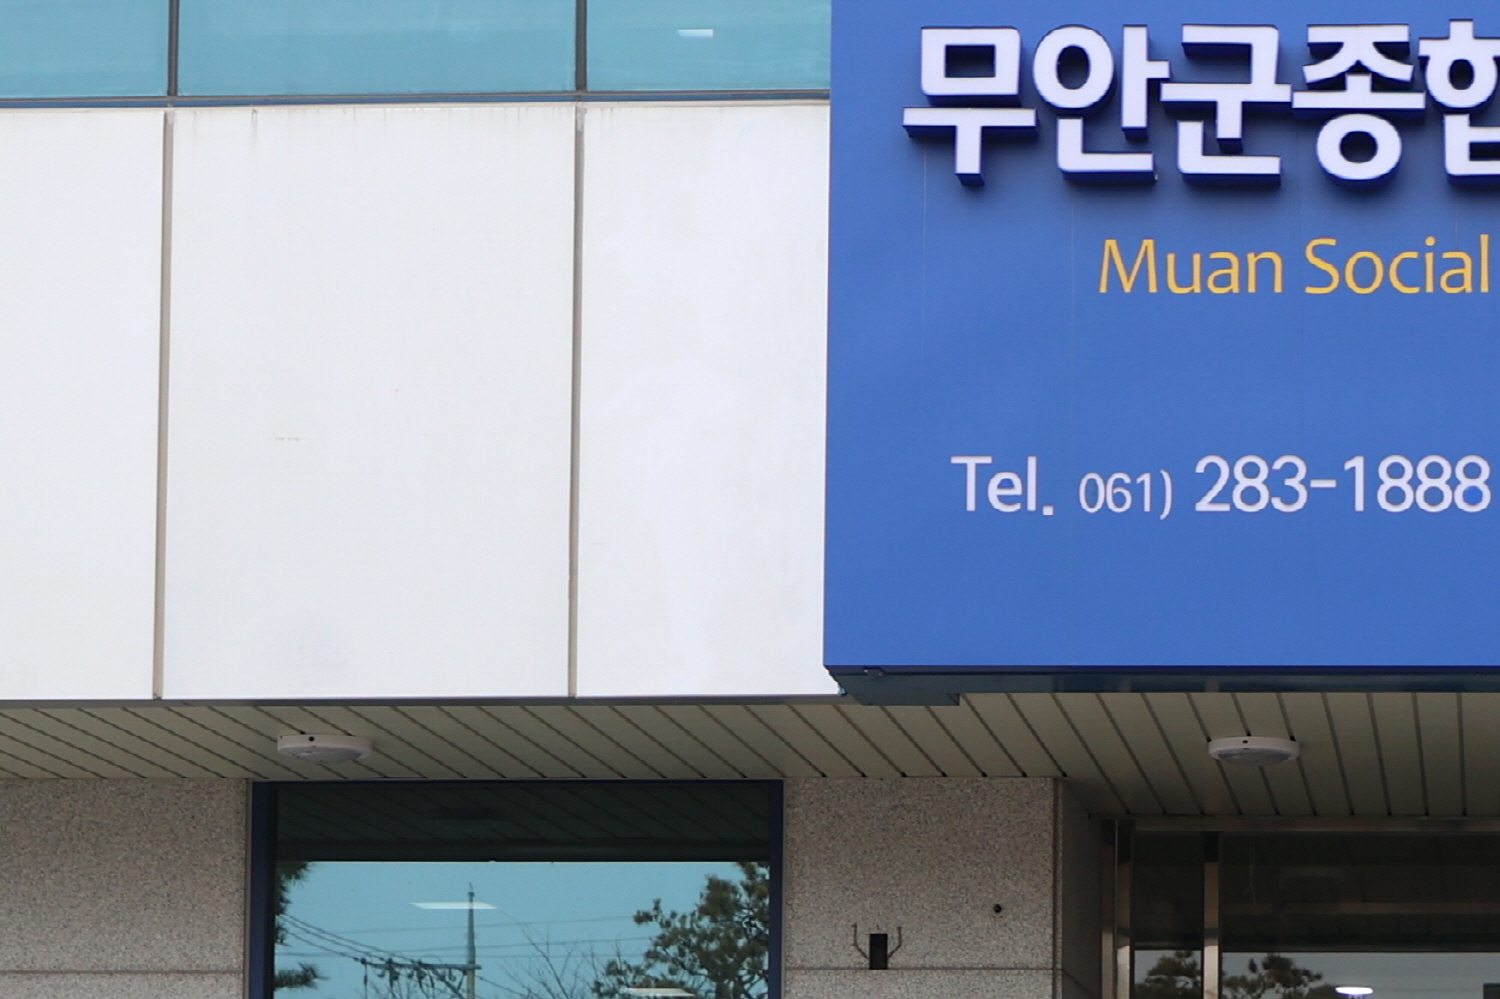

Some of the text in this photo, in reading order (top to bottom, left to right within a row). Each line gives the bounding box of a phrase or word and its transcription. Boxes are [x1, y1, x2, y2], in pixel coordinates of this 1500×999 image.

[1099, 238, 1283, 295] Muan
[1304, 233, 1490, 295] Social
[951, 455, 1054, 516] Tel.
[1079, 470, 1172, 520] 061)
[1195, 454, 1491, 514] 283-1888
